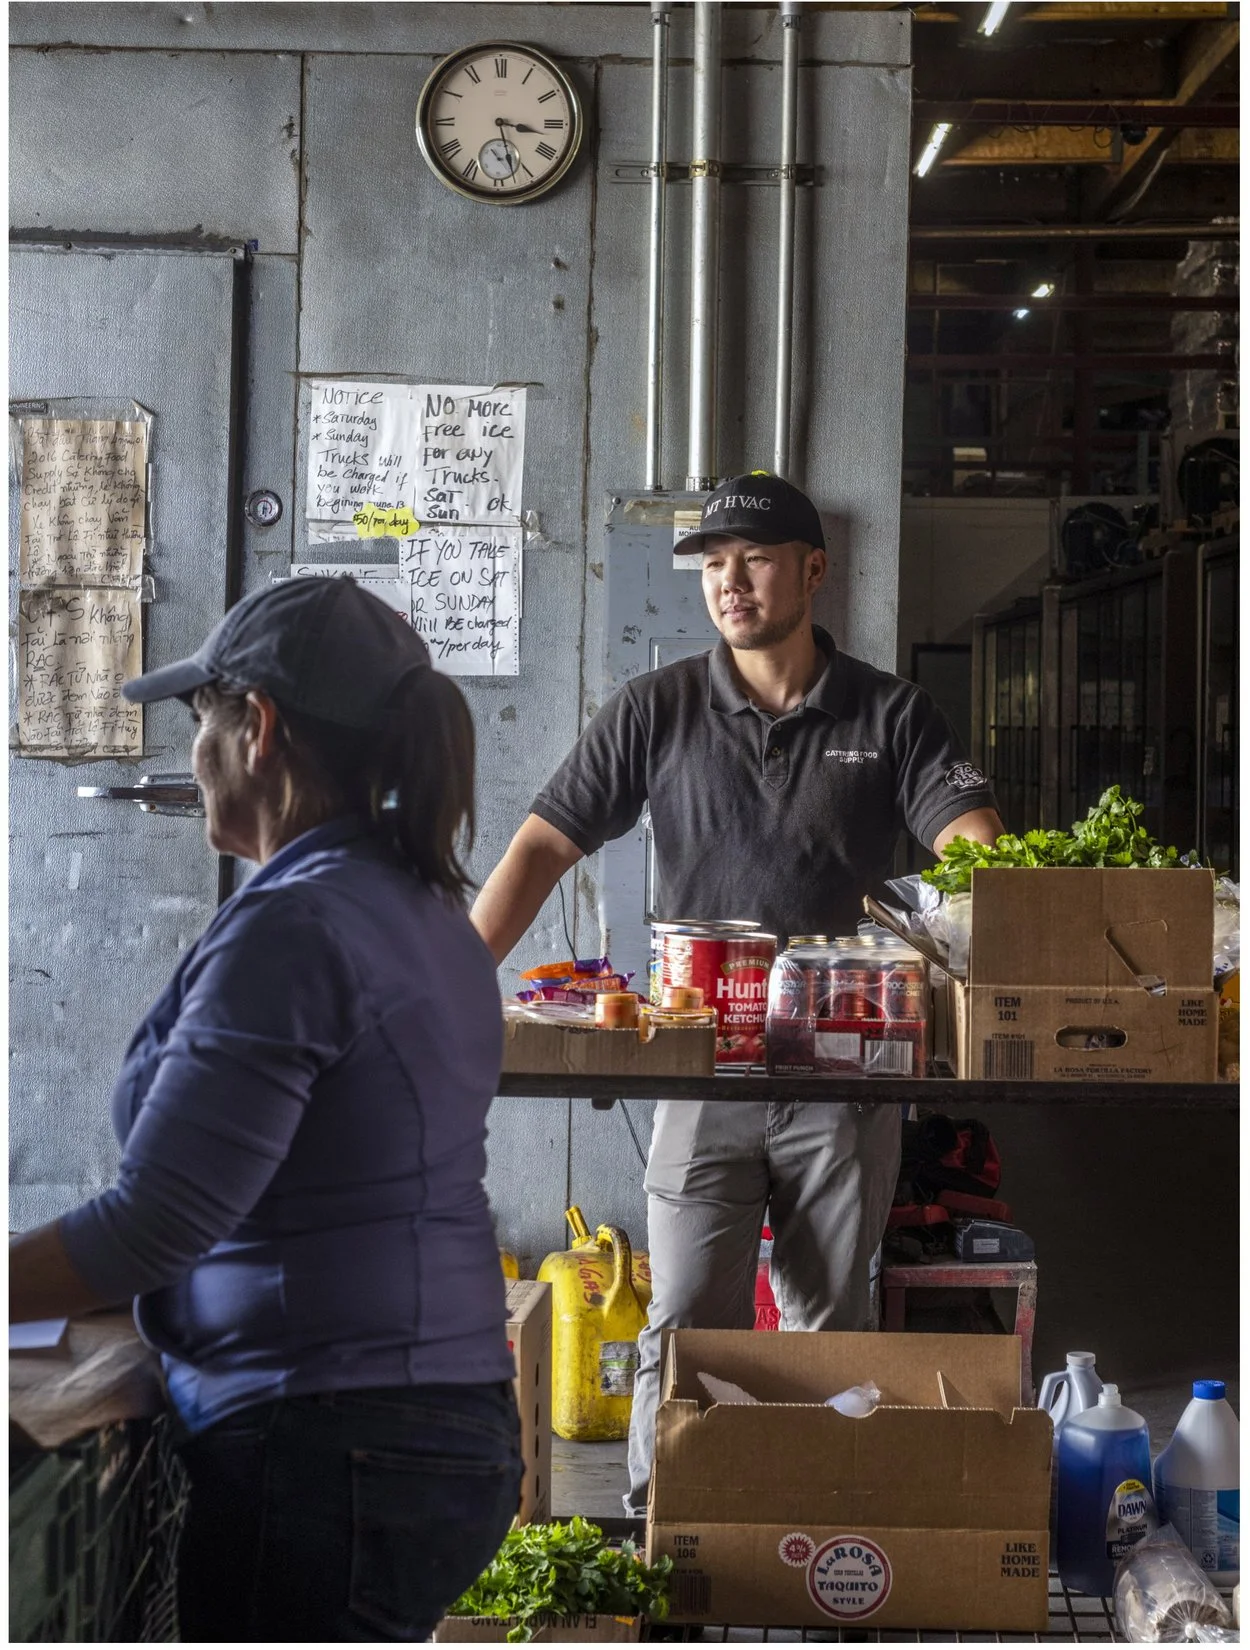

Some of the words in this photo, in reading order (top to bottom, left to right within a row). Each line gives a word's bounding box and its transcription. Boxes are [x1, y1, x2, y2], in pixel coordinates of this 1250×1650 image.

[544, 119, 563, 129] III
[482, 424, 514, 438] ice
[318, 448, 369, 467] Trucks
[317, 466, 337, 478] be
[396, 472, 409, 491] if
[317, 484, 340, 498] you
[350, 484, 384, 495] work
[724, 495, 771, 511] HVAC
[405, 538, 431, 563] IF
[469, 540, 511, 560] TAKE
[450, 571, 473, 586] ON
[477, 570, 510, 588] SAT
[435, 592, 495, 613] SUNDAY
[445, 616, 465, 631] BE
[472, 636, 504, 660] day
[994, 997, 1021, 1008] ITEM
[1181, 1000, 1204, 1008] LIKE
[998, 1011, 1018, 1021] 101
[1178, 1009, 1207, 1017] HOME
[1178, 1018, 1207, 1026] MADE
[1118, 1500, 1147, 1518] DAWN
[673, 1535, 699, 1546] ITEM
[676, 1548, 697, 1559] 106
[1006, 1543, 1036, 1553] LIKE
[1001, 1555, 1040, 1565] HOME
[1001, 1567, 1040, 1578] MADE
[818, 1581, 878, 1593] TAQUITO
[833, 1597, 865, 1605] STYLE
